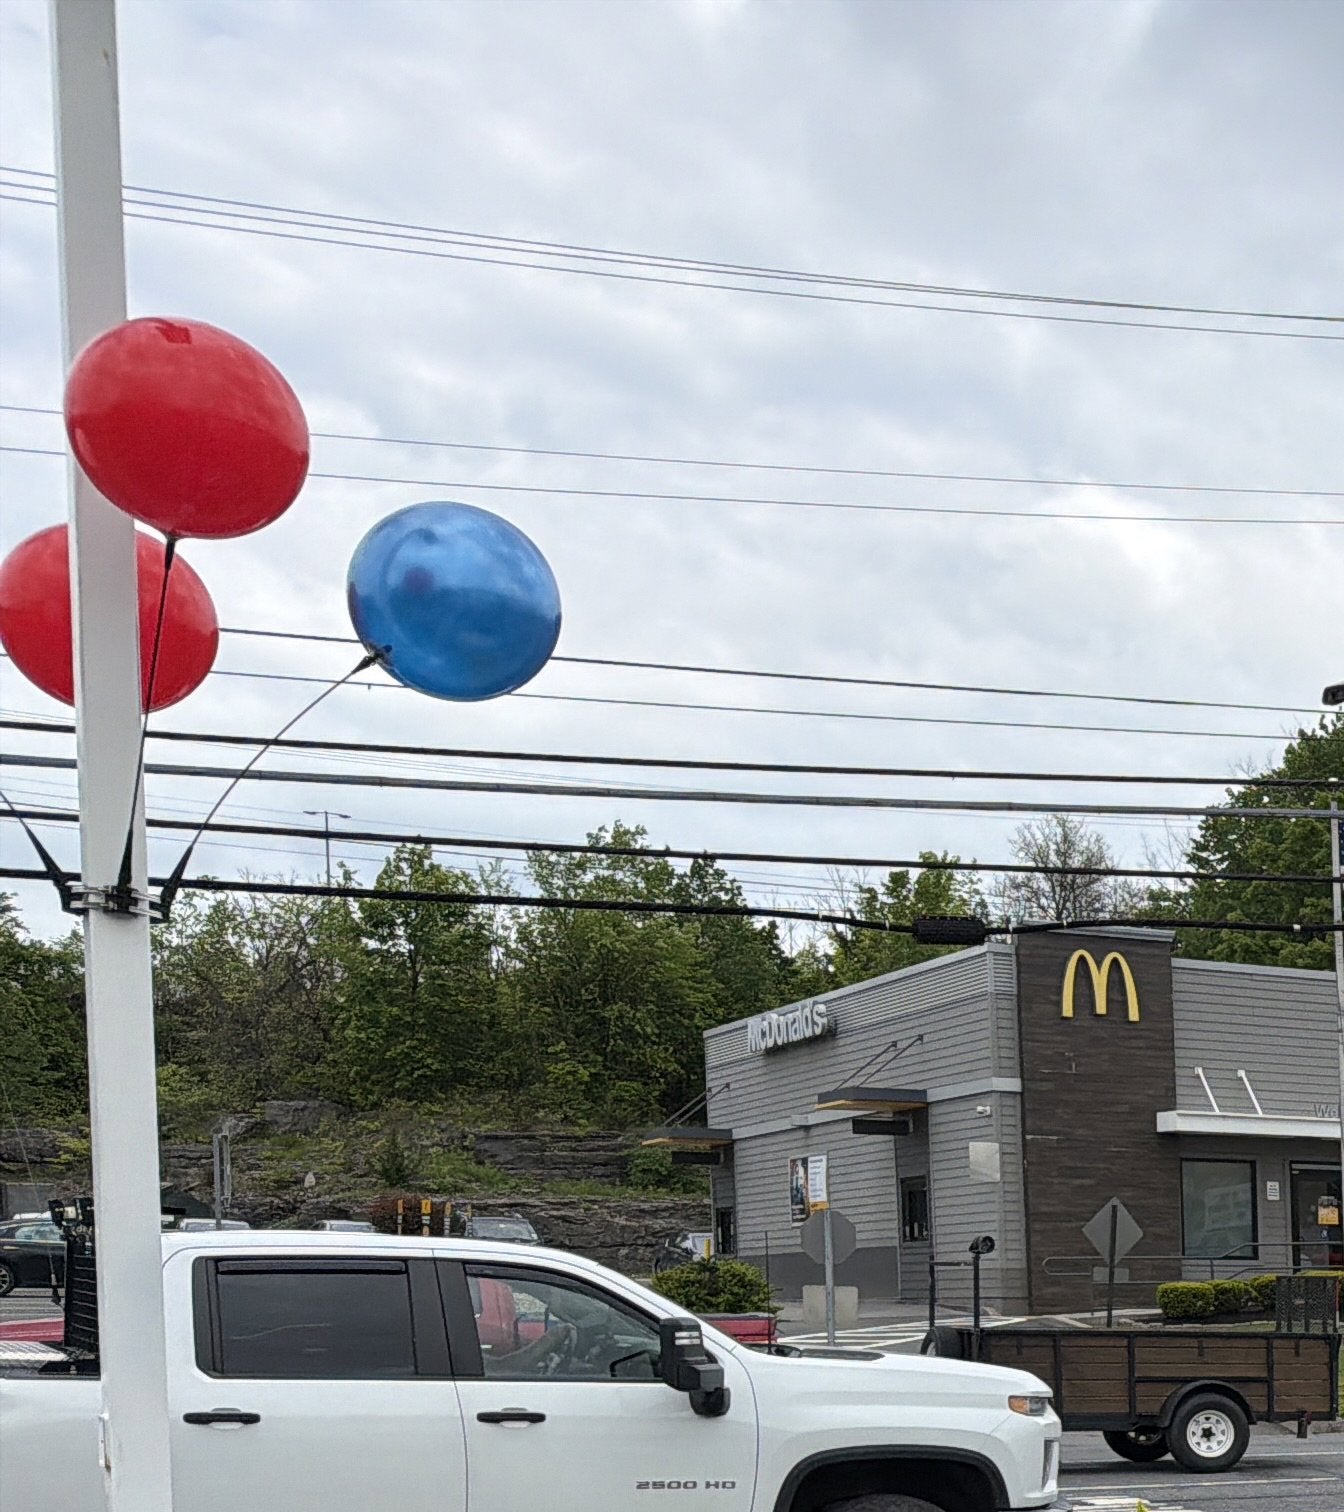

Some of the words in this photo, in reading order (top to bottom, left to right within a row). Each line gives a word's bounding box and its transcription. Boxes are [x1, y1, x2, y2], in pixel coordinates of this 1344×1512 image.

[747, 1000, 828, 1053] McDonald's
[636, 1480, 698, 1490] 2500
[704, 1480, 736, 1490] HD
